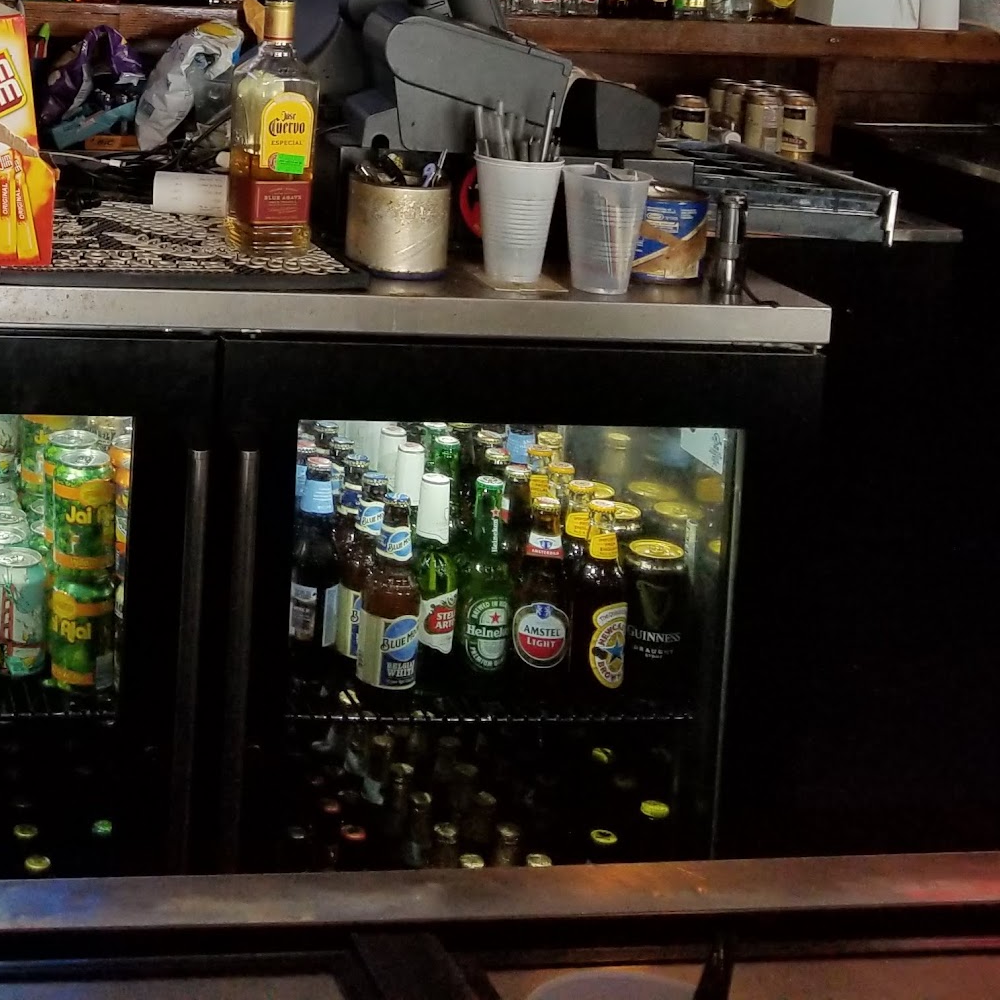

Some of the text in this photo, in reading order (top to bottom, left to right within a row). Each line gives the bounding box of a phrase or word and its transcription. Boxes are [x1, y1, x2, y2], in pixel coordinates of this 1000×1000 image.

[268, 118, 305, 136] Cuervo
[15, 188, 25, 220] ORIGINAL
[66, 505, 92, 525] Jai
[491, 518, 499, 553] Heineken
[387, 541, 401, 553] BLUE
[531, 548, 560, 556] AMSTERDAM
[472, 603, 490, 620] BREWED
[60, 619, 92, 643] Alai
[523, 625, 560, 637] AMSTEL
[627, 625, 681, 642] GUINNESS
[381, 636, 405, 652] BLUE
[527, 636, 555, 648] LIGHT
[633, 645, 674, 655] DRAUGHT
